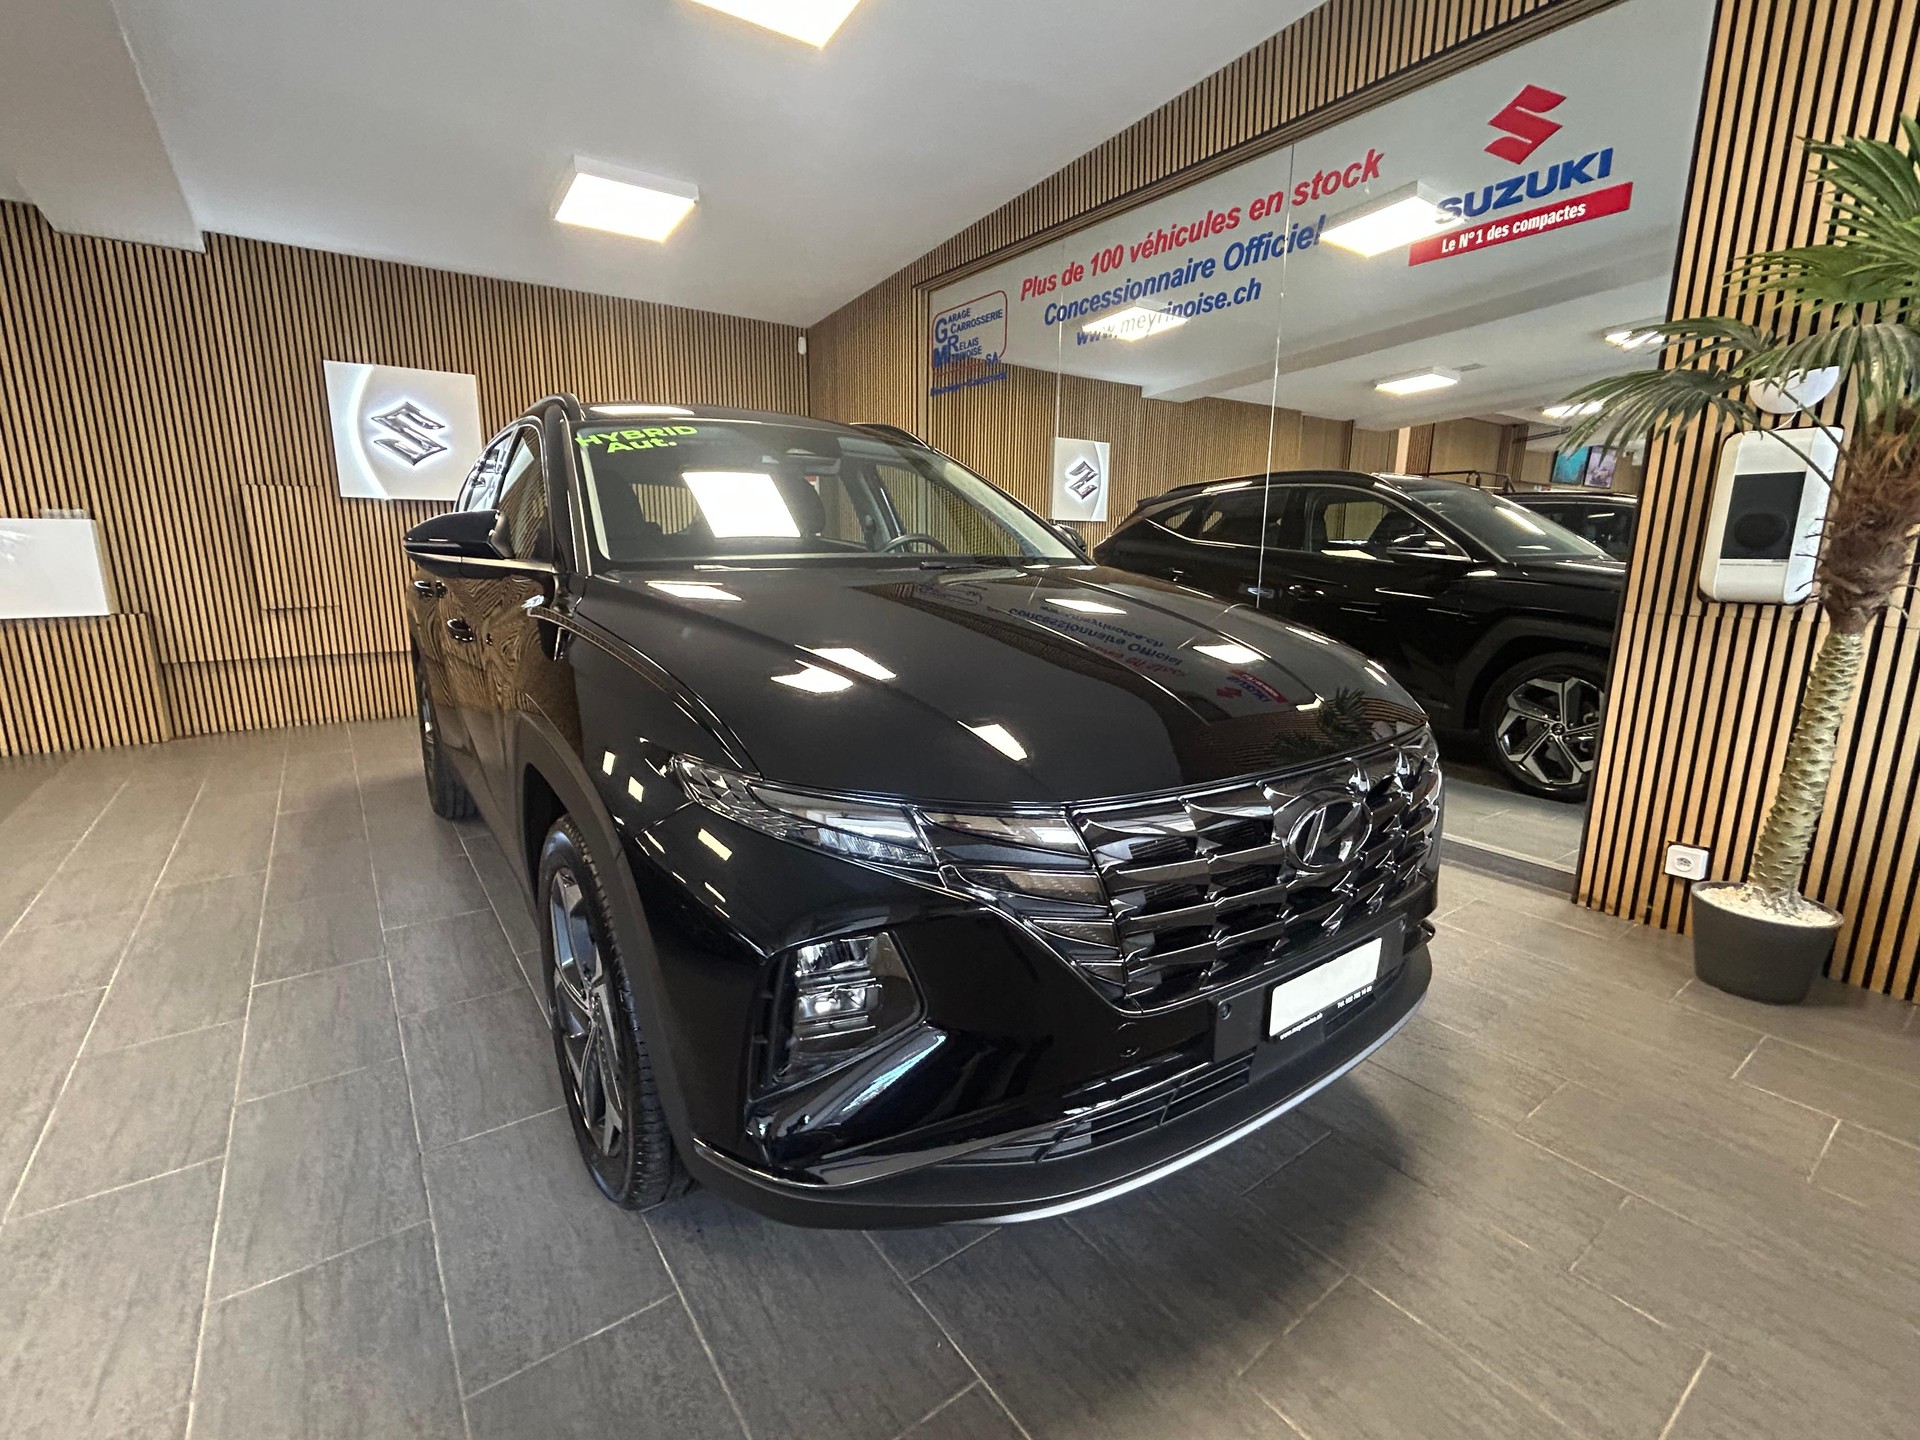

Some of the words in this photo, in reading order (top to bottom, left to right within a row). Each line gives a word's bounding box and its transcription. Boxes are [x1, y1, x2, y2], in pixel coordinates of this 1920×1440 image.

[1435, 147, 1614, 224] SUZUKI
[1020, 273, 1057, 301] Plus
[1061, 261, 1084, 287] de
[1090, 244, 1124, 277] 100
[1129, 206, 1241, 263] véhicules
[1249, 191, 1284, 221] en
[1291, 148, 1385, 206] stock
[1441, 238, 1456, 253] Le
[1487, 224, 1509, 242] des
[1512, 203, 1586, 234] compactes
[1044, 257, 1216, 326] Concessionnaire
[1223, 214, 1326, 271] Officiel
[950, 308, 1003, 334] CARROSSERIE
[575, 426, 697, 447] HYBRID
[607, 438, 677, 453] Aut.
